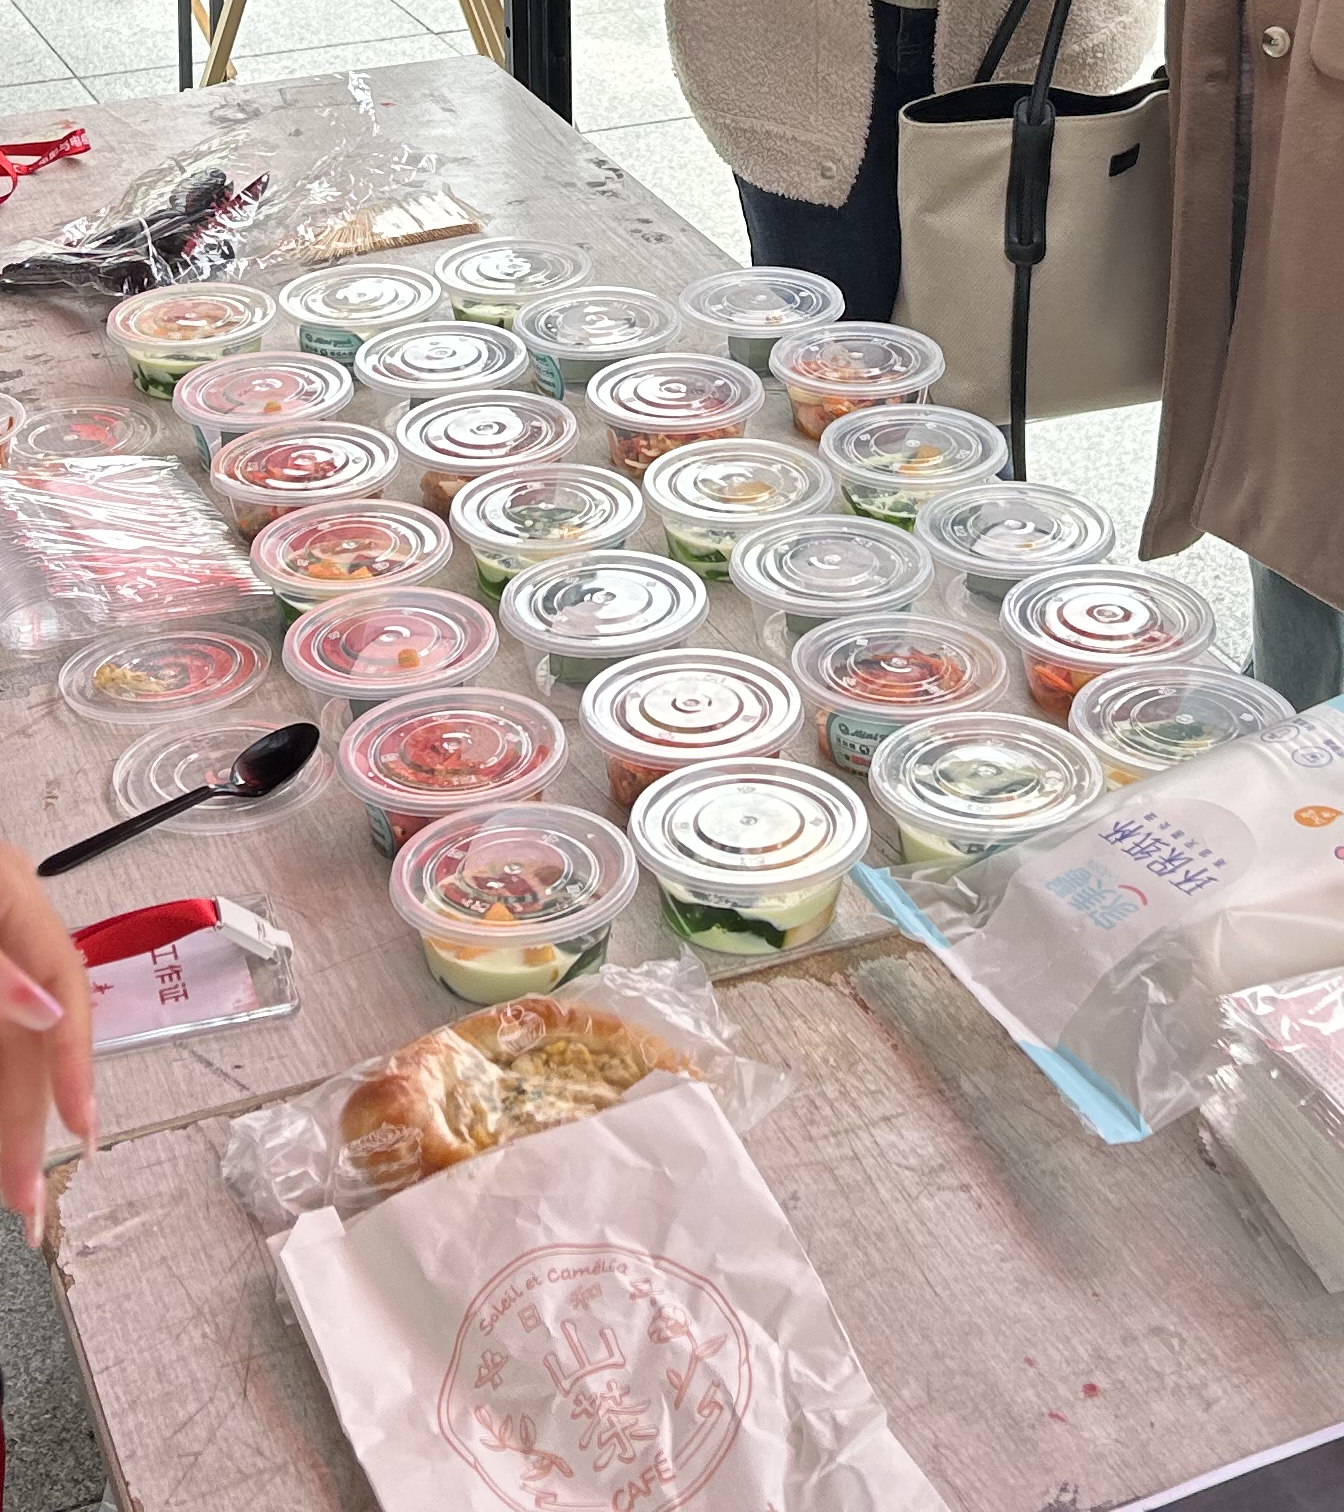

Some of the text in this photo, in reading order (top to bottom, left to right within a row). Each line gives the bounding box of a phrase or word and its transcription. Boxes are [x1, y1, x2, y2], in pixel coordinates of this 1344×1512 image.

[1099, 819, 1219, 896] 环保纸杯
[151, 944, 189, 1005] 工作证
[479, 1284, 524, 1336] Soleil
[526, 1272, 543, 1290] et
[543, 1319, 659, 1471] 山茶
